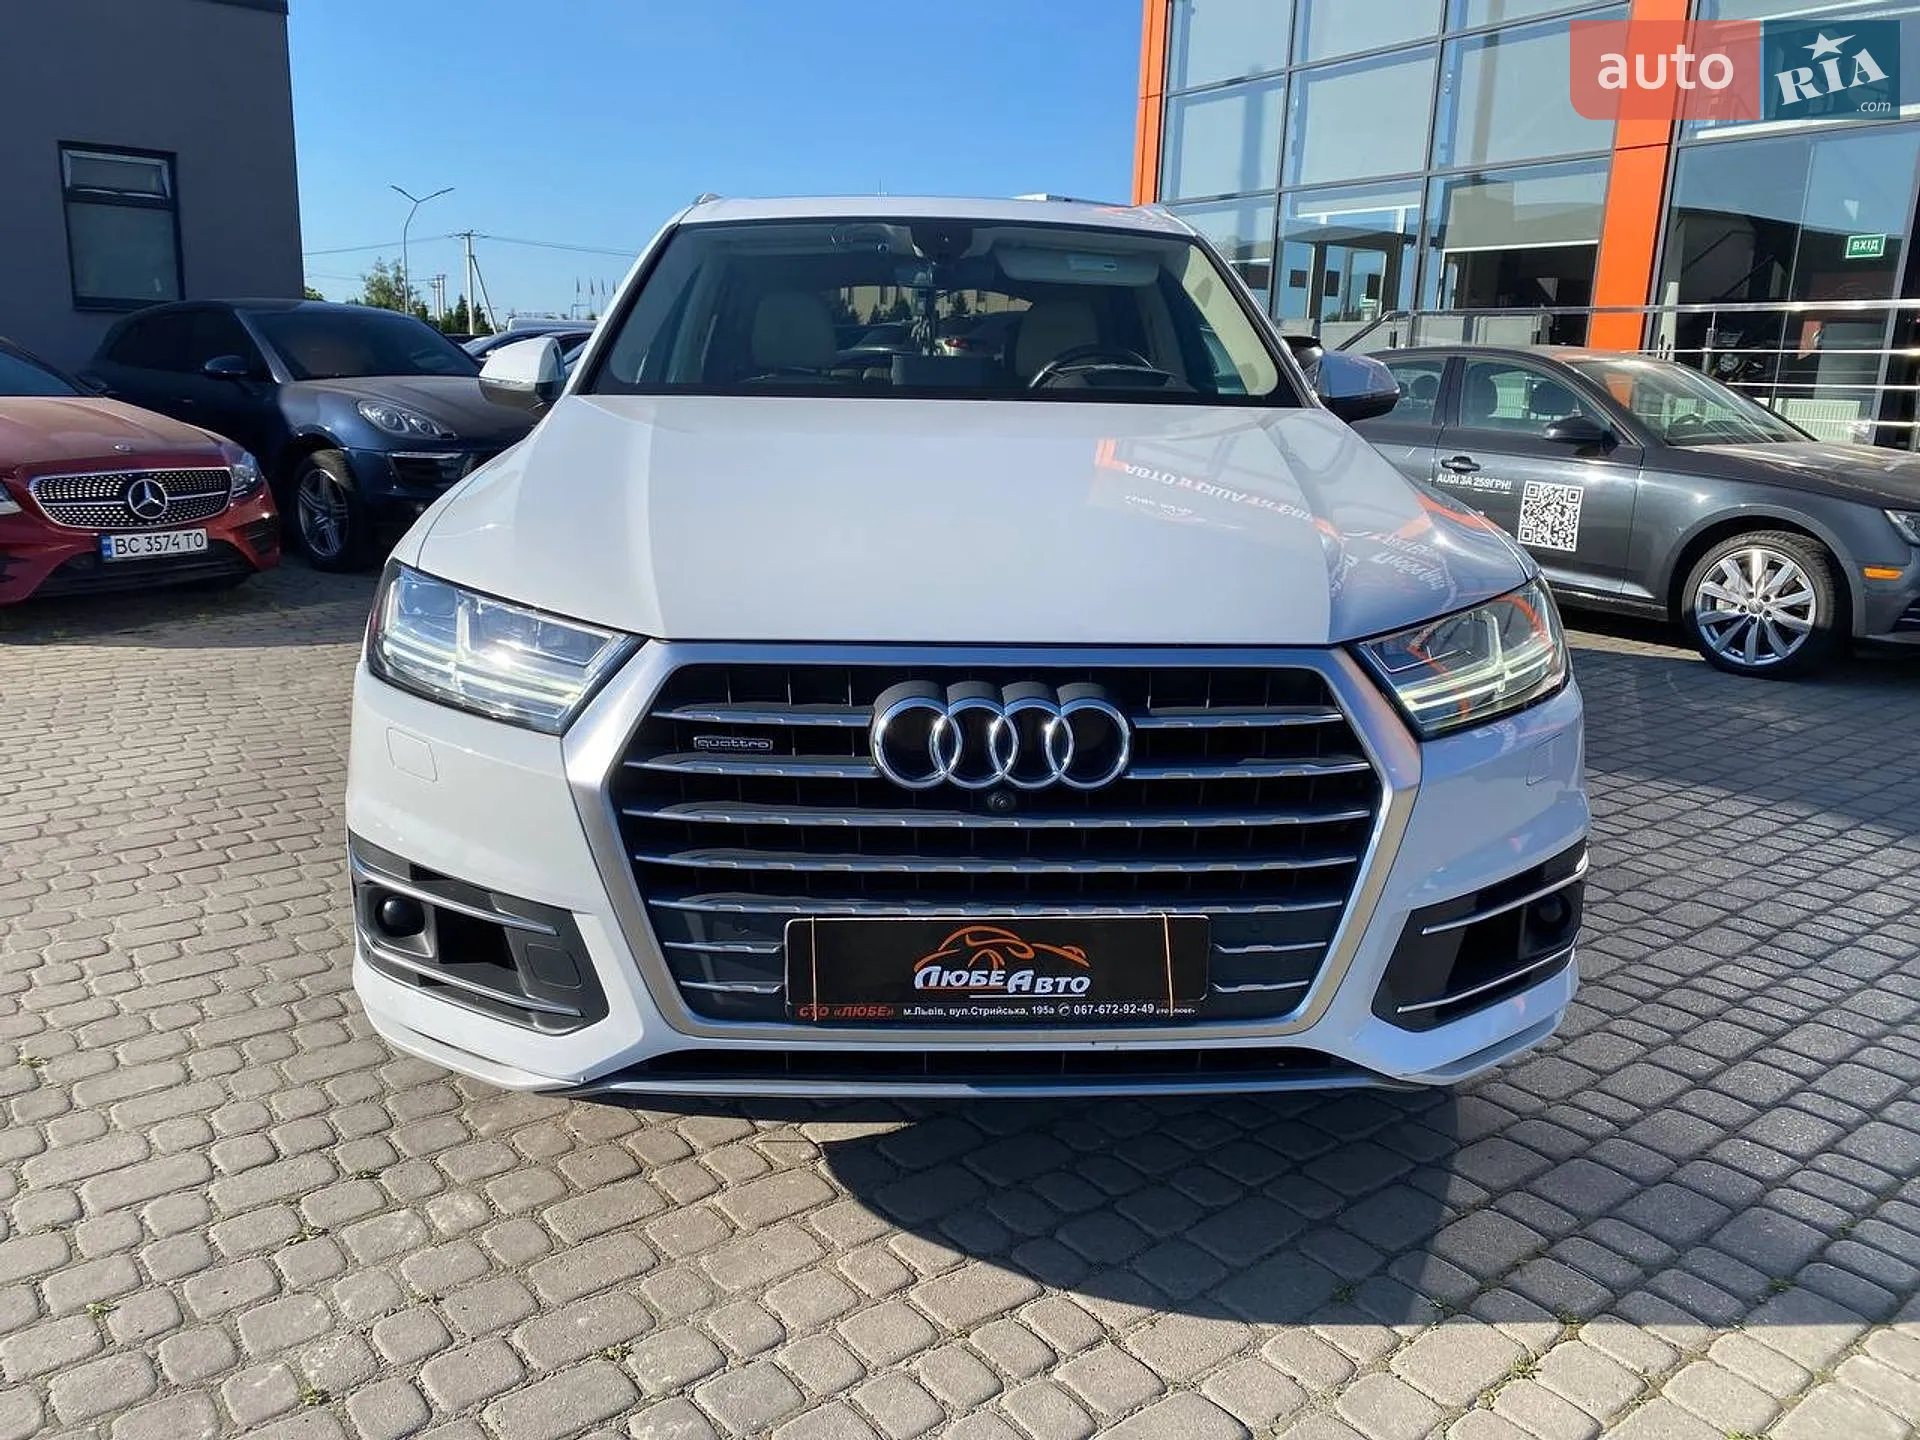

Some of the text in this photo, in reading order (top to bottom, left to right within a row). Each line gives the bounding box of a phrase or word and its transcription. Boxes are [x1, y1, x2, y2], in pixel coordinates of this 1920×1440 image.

[115, 537, 140, 555] BC
[144, 534, 180, 552] 3574
[183, 532, 204, 549] TO
[697, 739, 770, 750] quattro
[800, 1005, 829, 1017] СТО
[1073, 1003, 1155, 1015] 067-672-92-49
